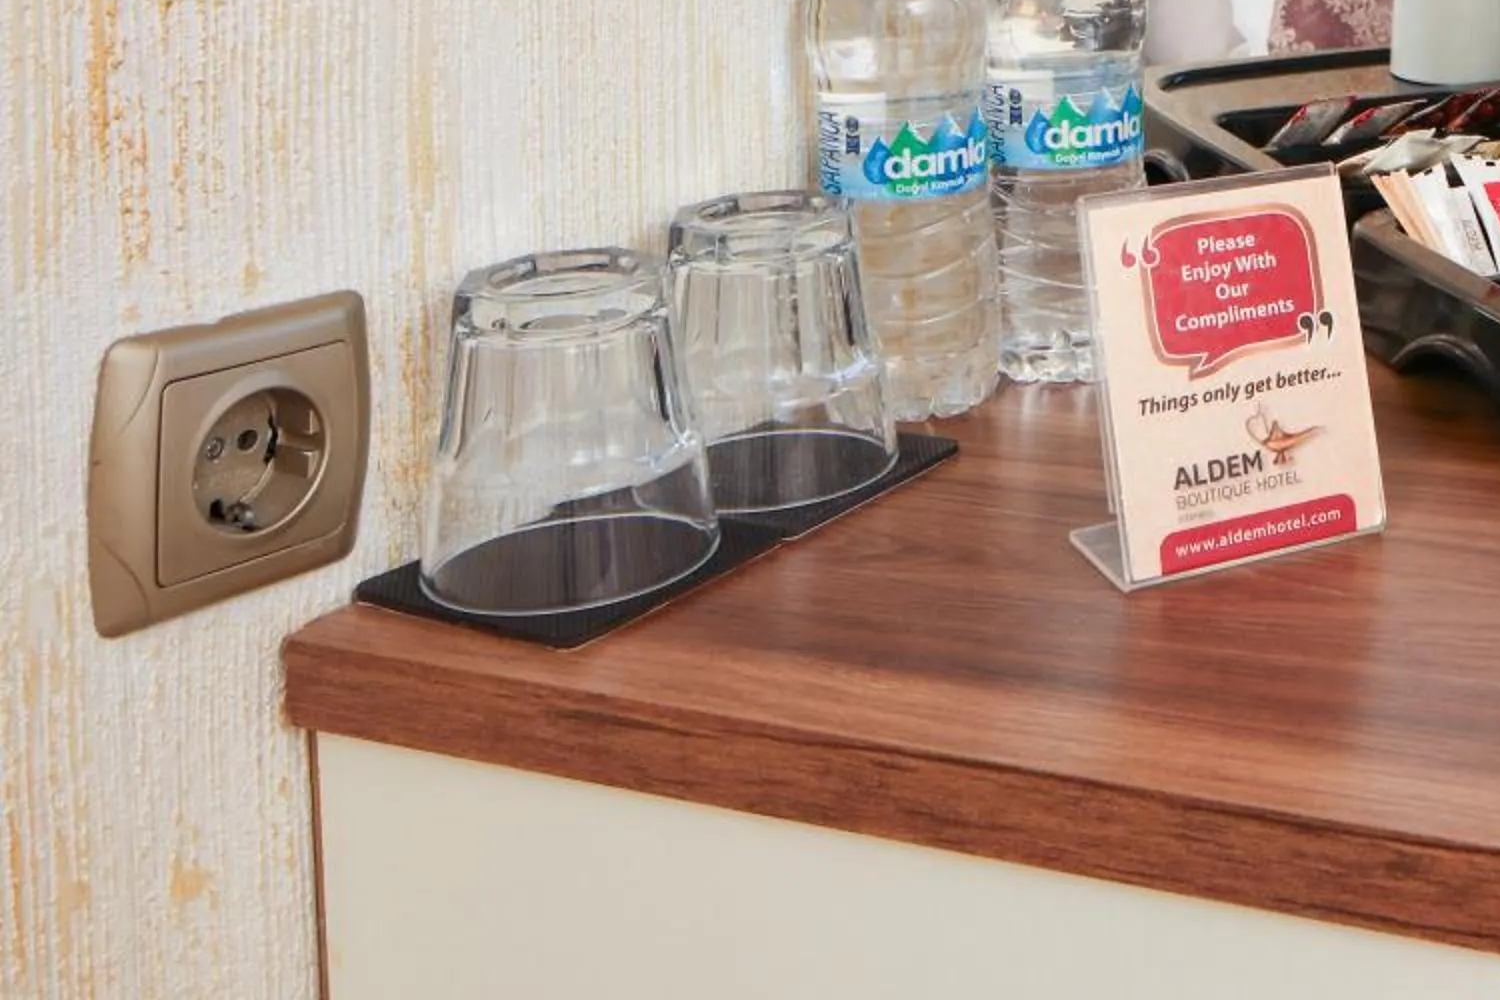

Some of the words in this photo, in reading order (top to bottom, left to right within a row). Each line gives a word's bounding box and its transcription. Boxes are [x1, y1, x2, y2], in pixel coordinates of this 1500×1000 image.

[1044, 112, 1141, 148] damla
[884, 137, 986, 179] damla
[1197, 234, 1256, 255] Please
[1181, 260, 1232, 282] Enjoy
[1233, 250, 1277, 272] With
[1215, 283, 1249, 299] Our
[1175, 298, 1295, 332] Compliments
[1138, 391, 1198, 416] Things
[1202, 382, 1241, 404] only
[1245, 376, 1272, 399] get
[1276, 367, 1342, 389] better...
[1173, 449, 1265, 491] ALDEM
[1176, 480, 1251, 511] BOUTIQUE
[1256, 470, 1301, 492] HOTEL
[1175, 507, 1342, 558] www.aldemhotel.com
